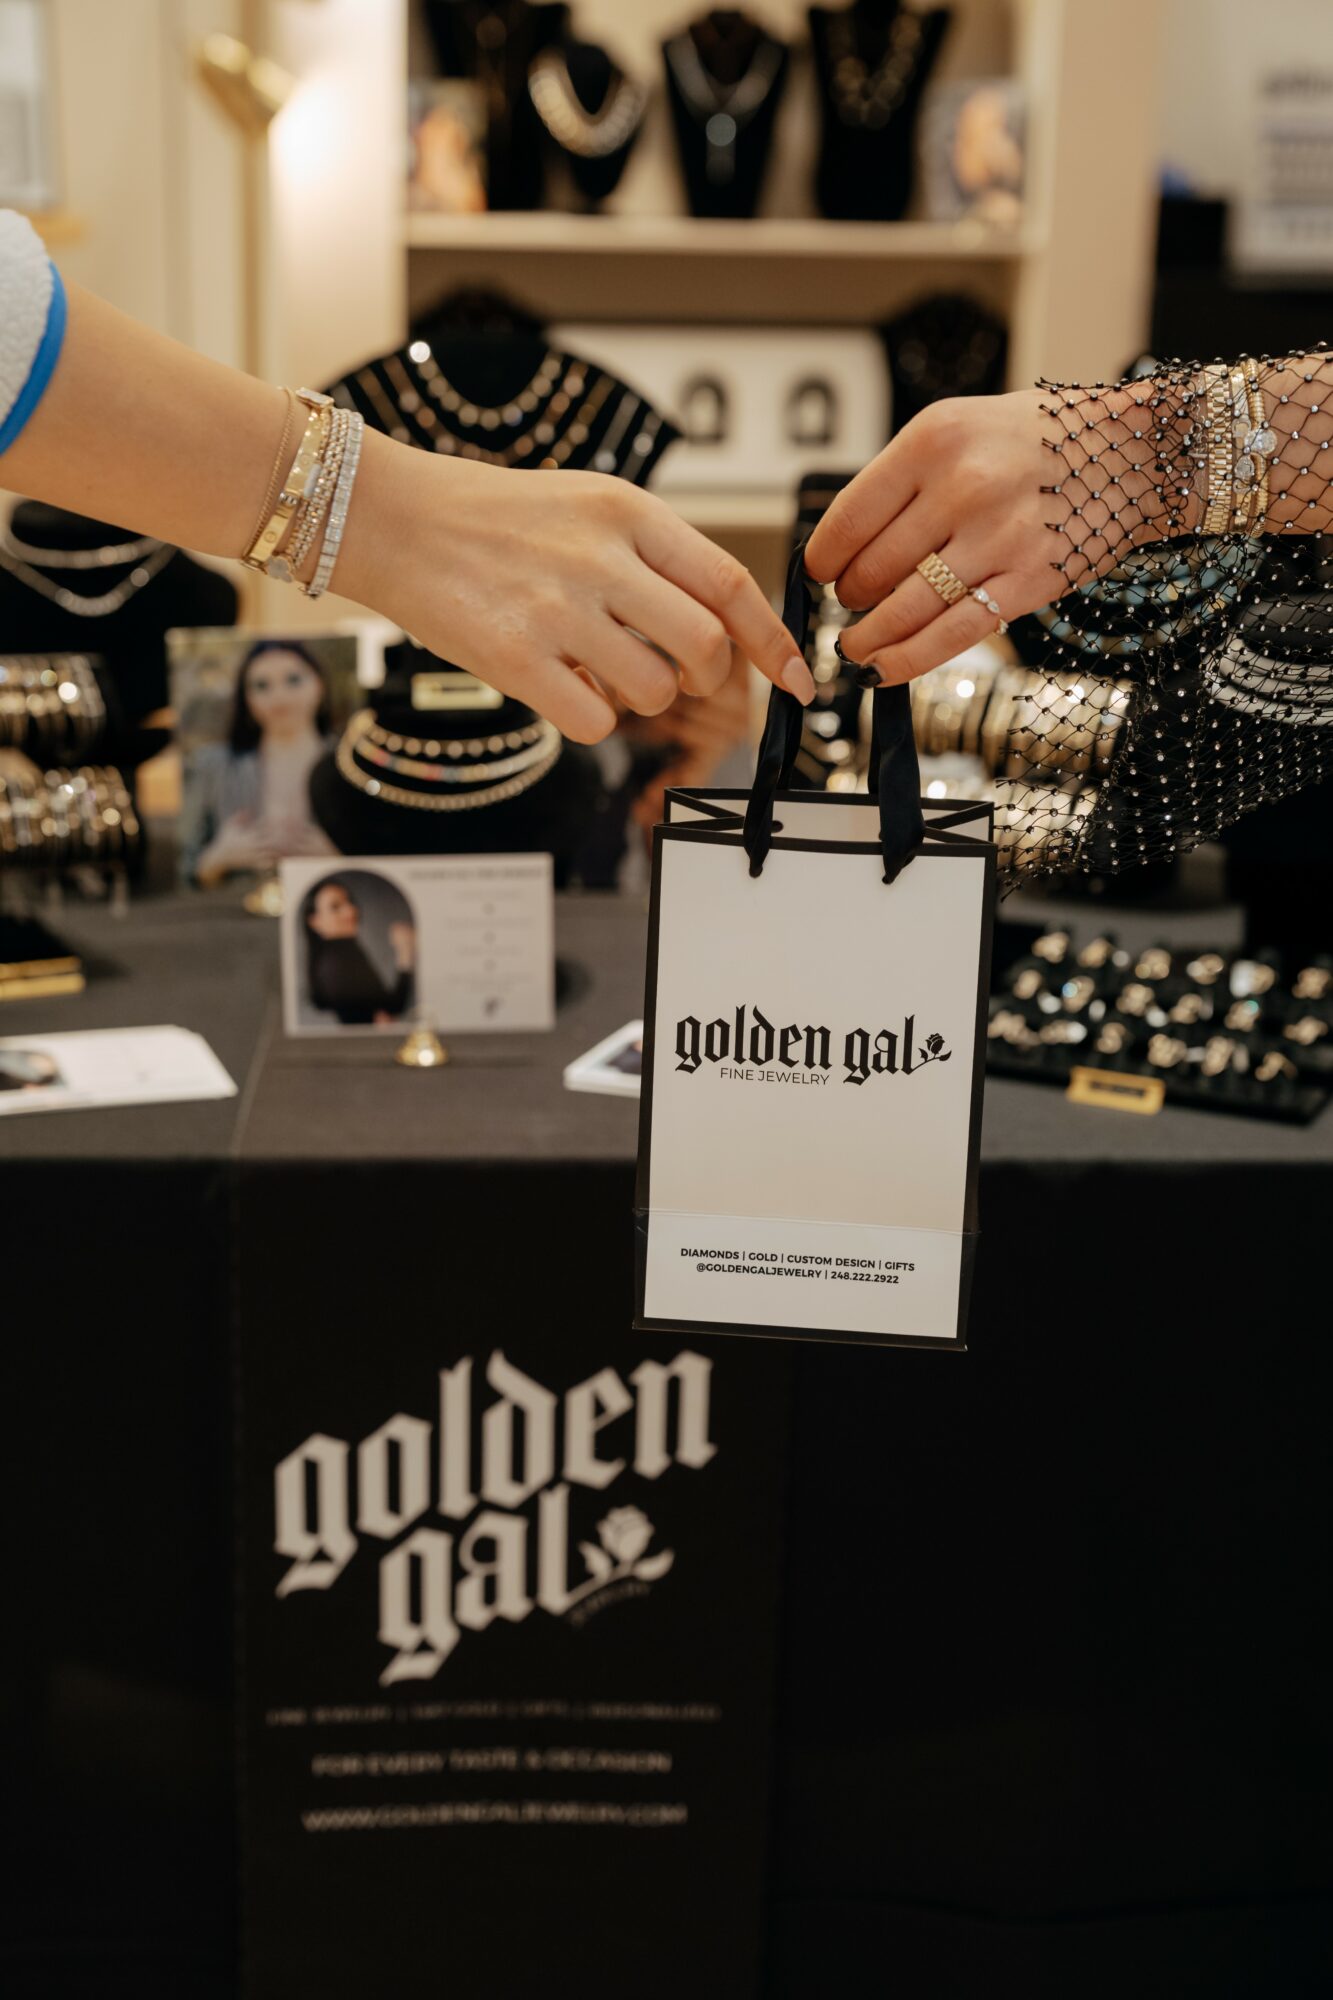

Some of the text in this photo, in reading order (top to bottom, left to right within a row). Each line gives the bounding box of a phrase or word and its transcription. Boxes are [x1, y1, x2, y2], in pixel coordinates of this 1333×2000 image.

[675, 1003, 916, 1086] golden gal
[720, 1067, 830, 1086] FINE JEWELRY
[680, 1248, 740, 1260] DIAMONDS
[748, 1252, 778, 1262] GOLD
[787, 1254, 832, 1266] CUSTOM
[836, 1257, 876, 1269] DESIGN
[885, 1261, 915, 1272] GIFTS
[696, 1262, 822, 1279] @GOLDENGALJEWELRY
[831, 1271, 900, 1284] 248.222.2922
[274, 1350, 718, 1599] golden
[378, 1483, 571, 1688] gal
